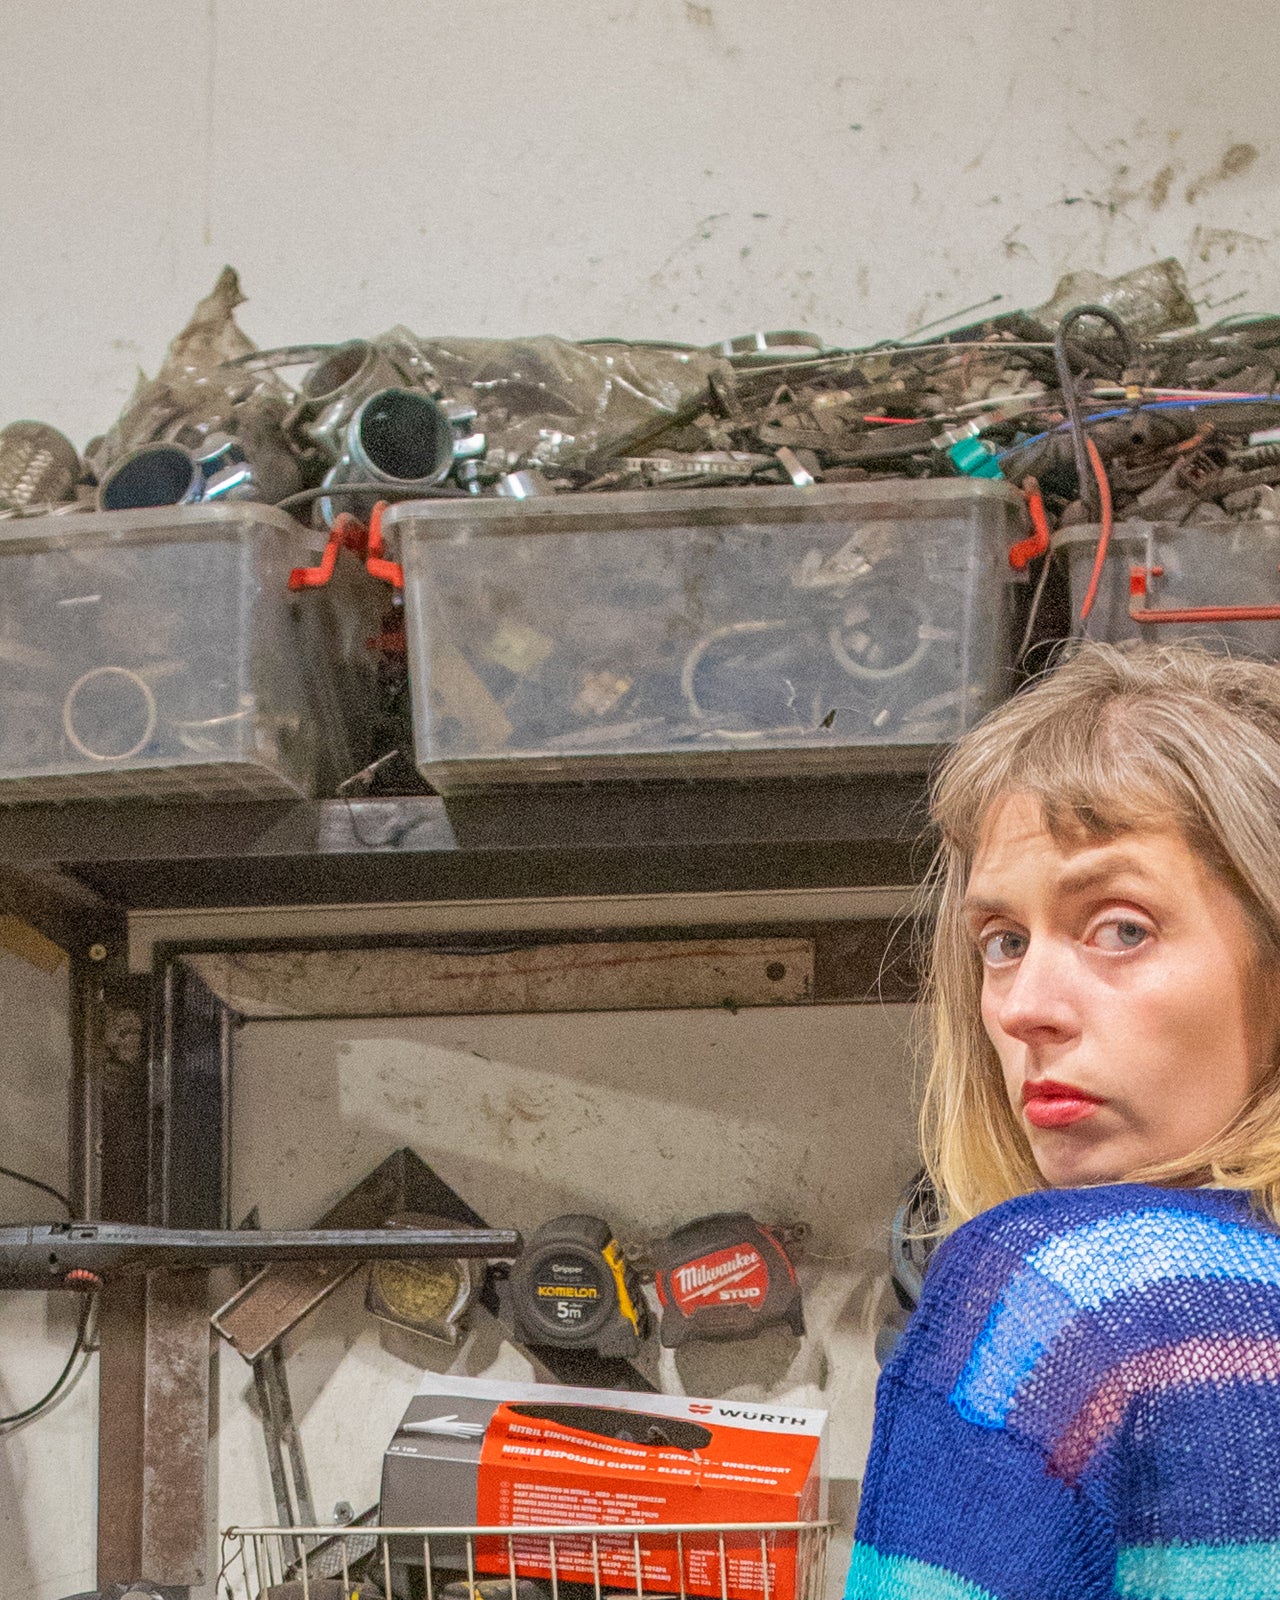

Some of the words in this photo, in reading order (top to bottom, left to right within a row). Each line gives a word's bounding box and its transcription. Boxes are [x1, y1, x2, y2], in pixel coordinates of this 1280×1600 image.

[675, 1252, 759, 1294] Milwaukee
[719, 1287, 761, 1300] STUD
[719, 1408, 806, 1426] WÜRTH
[508, 1423, 541, 1437] NITRIL
[658, 1452, 711, 1465] SCHWZ
[502, 1445, 542, 1457] NITRILE
[543, 1449, 605, 1467] DISPOSABLE
[607, 1461, 646, 1471] GLOVES
[658, 1466, 691, 1476] BLACK
[704, 1472, 778, 1486] UNPOWDERED
